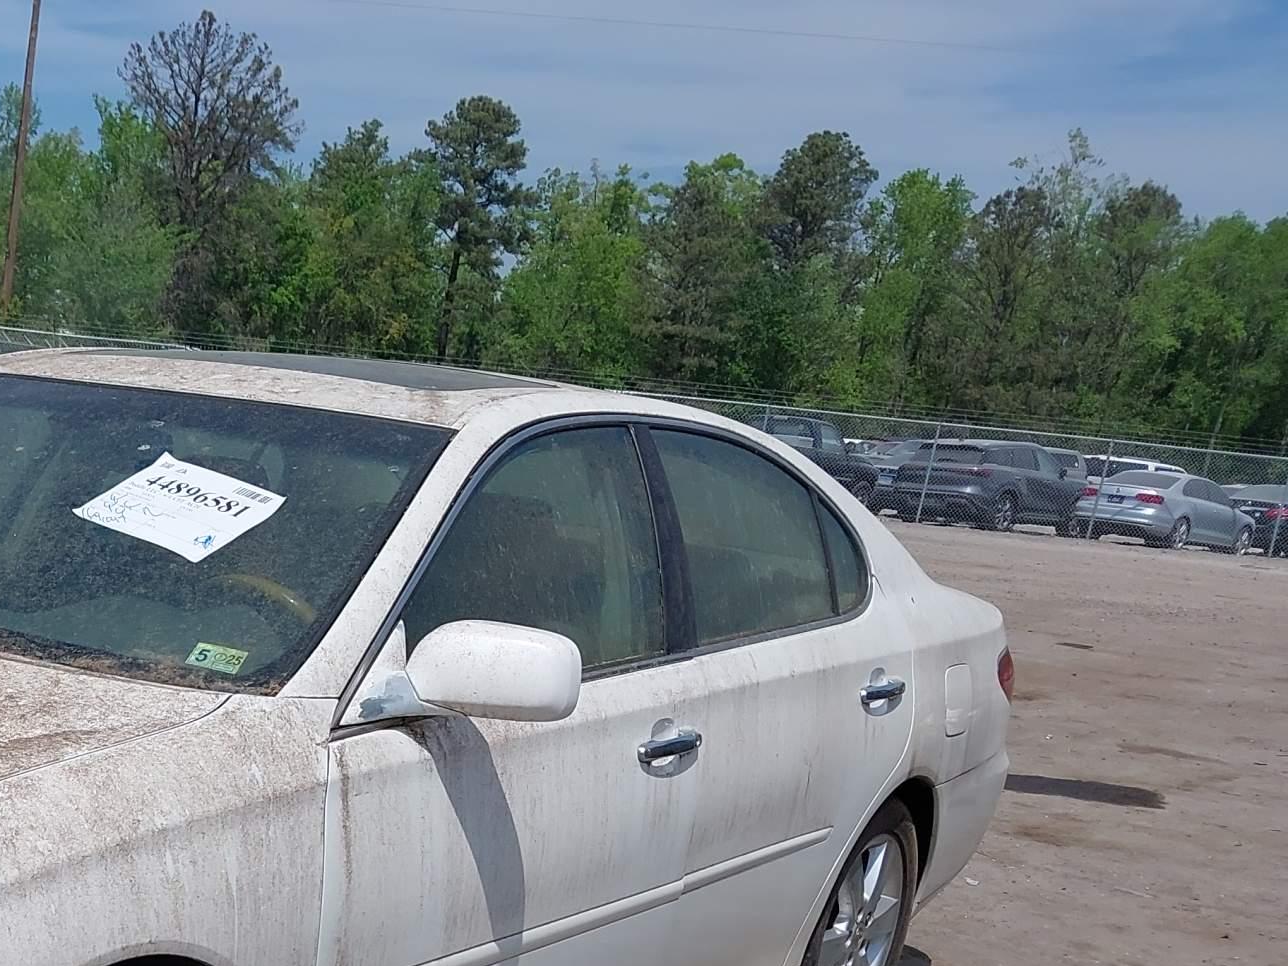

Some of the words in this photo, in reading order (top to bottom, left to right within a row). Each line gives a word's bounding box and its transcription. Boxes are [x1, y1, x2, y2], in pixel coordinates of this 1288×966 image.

[146, 475, 250, 518] 44896581
[195, 649, 211, 662] 5
[226, 654, 243, 666] 25
